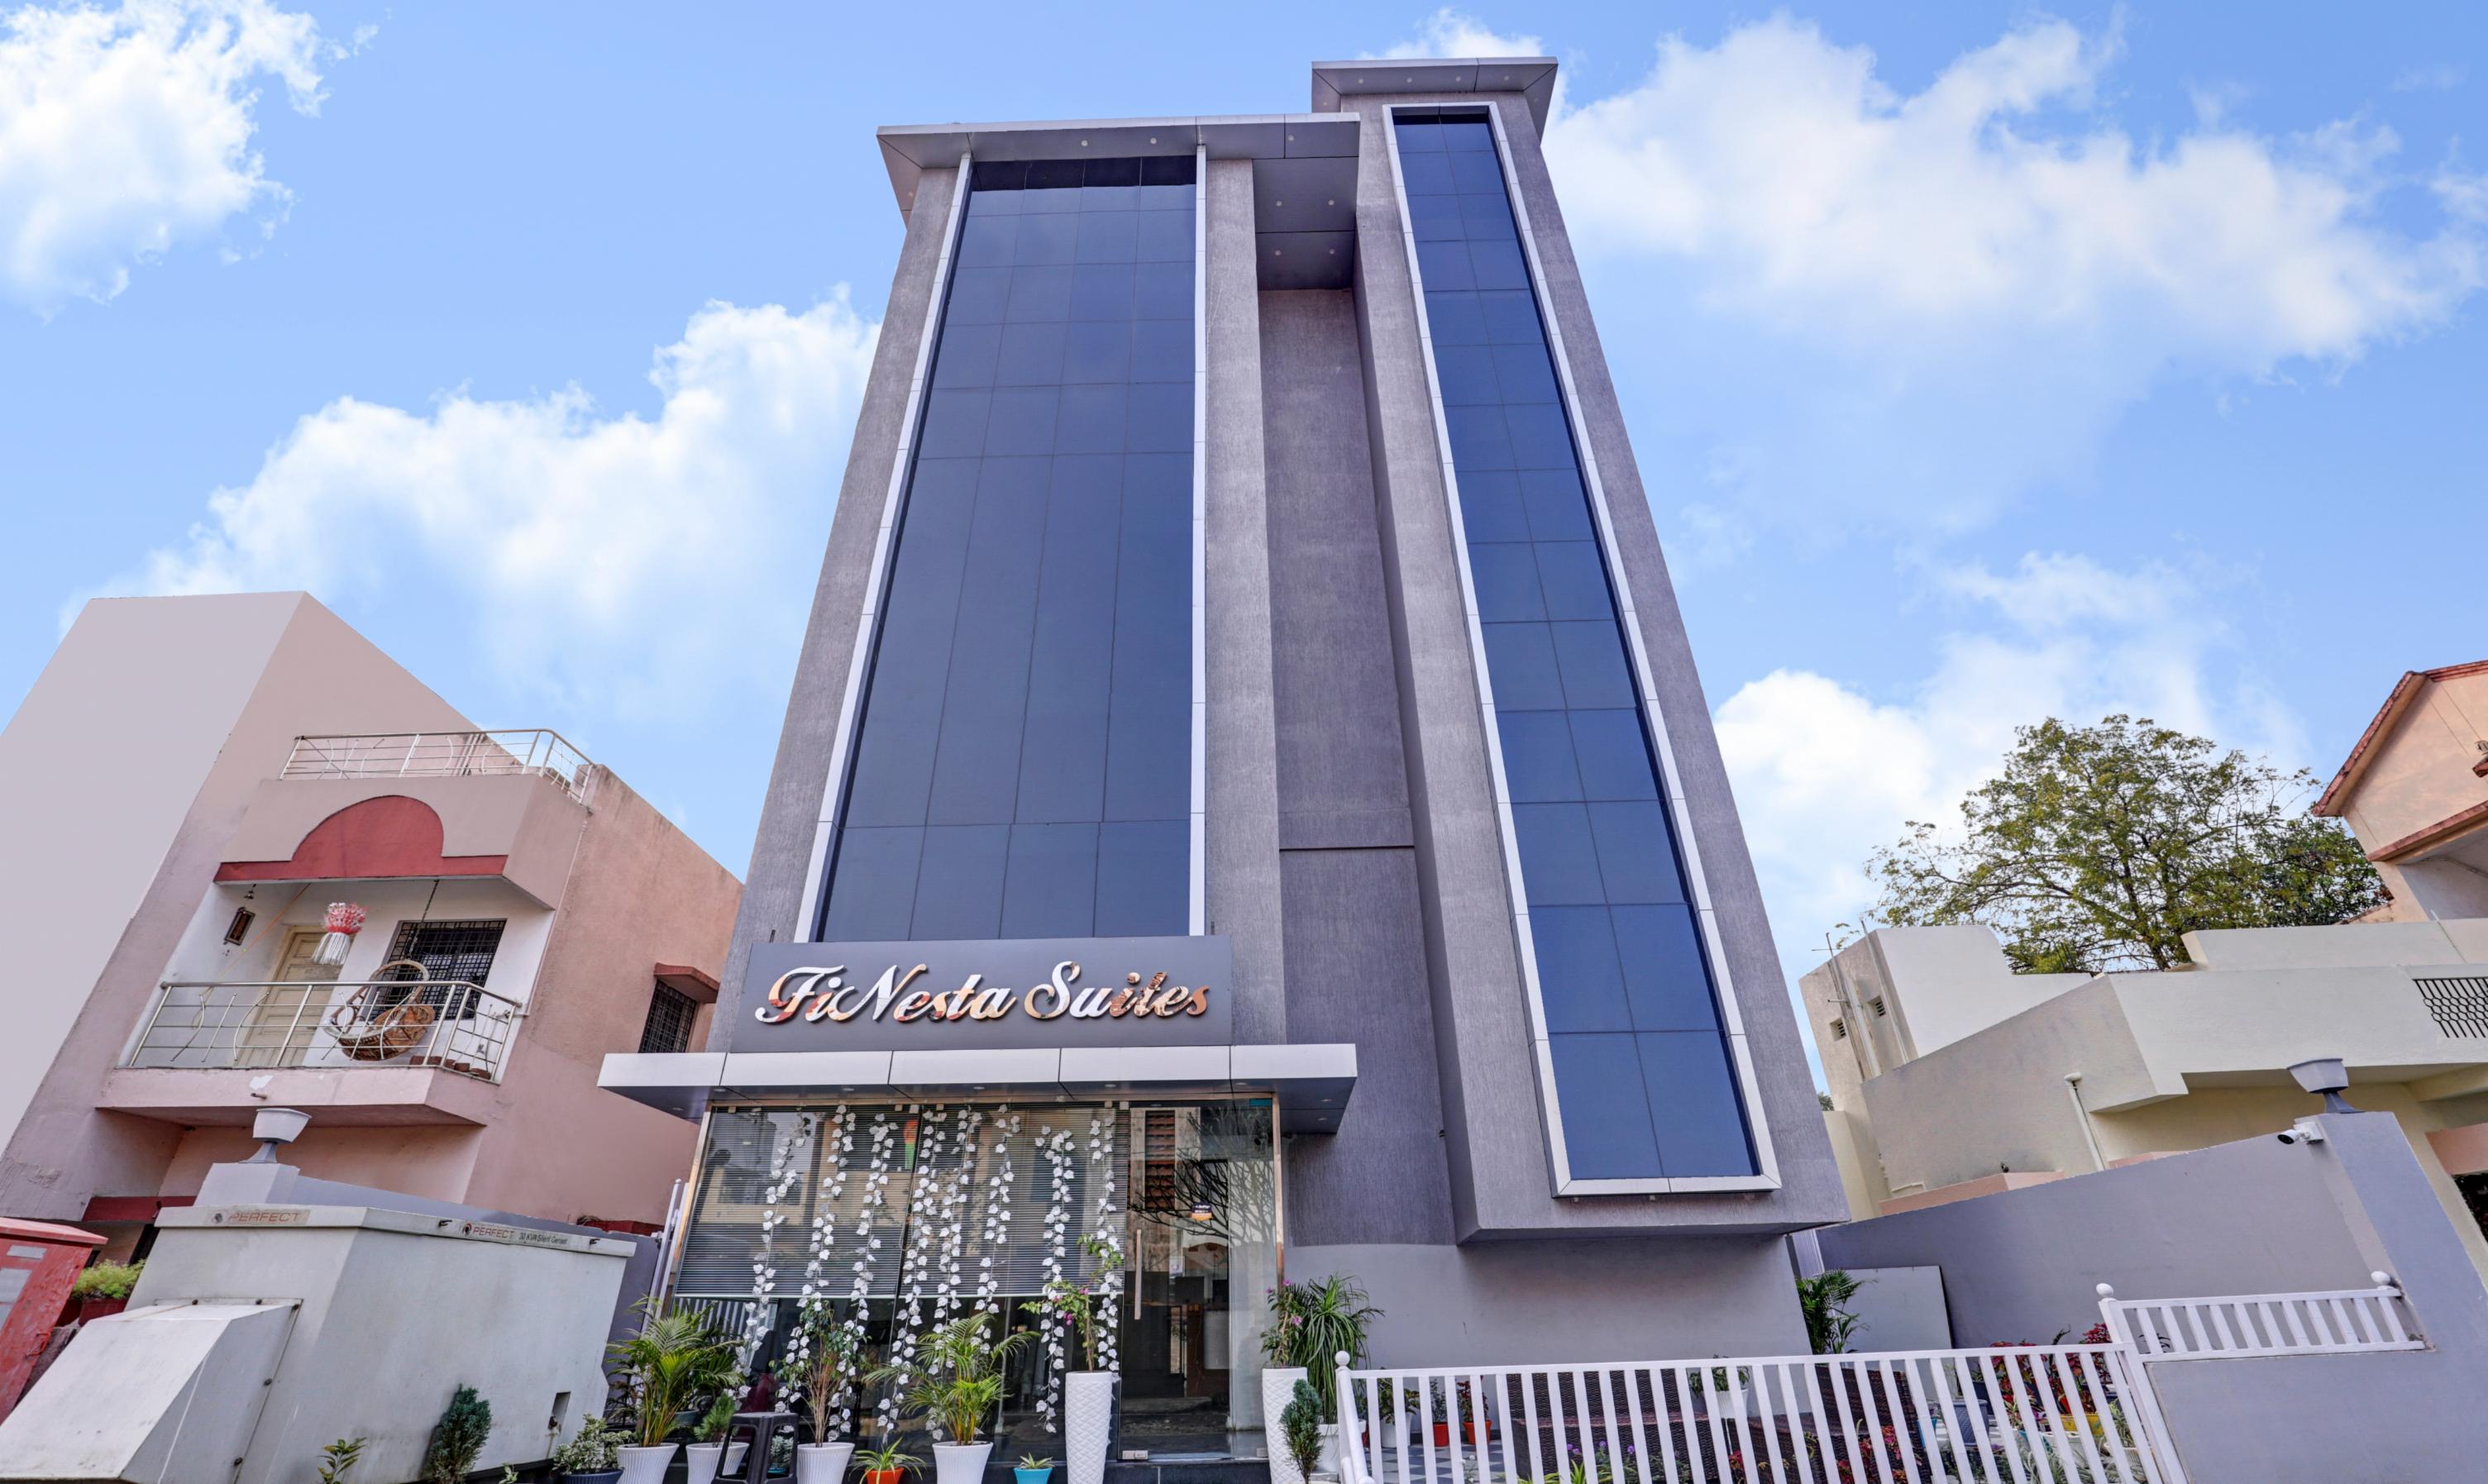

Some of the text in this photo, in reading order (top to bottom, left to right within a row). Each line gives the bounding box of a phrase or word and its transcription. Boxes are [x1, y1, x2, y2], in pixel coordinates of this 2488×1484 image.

[754, 961, 1211, 1024] FiNesta Suites
[228, 1211, 301, 1223] PERFECT
[473, 1226, 514, 1239] PERFECT
